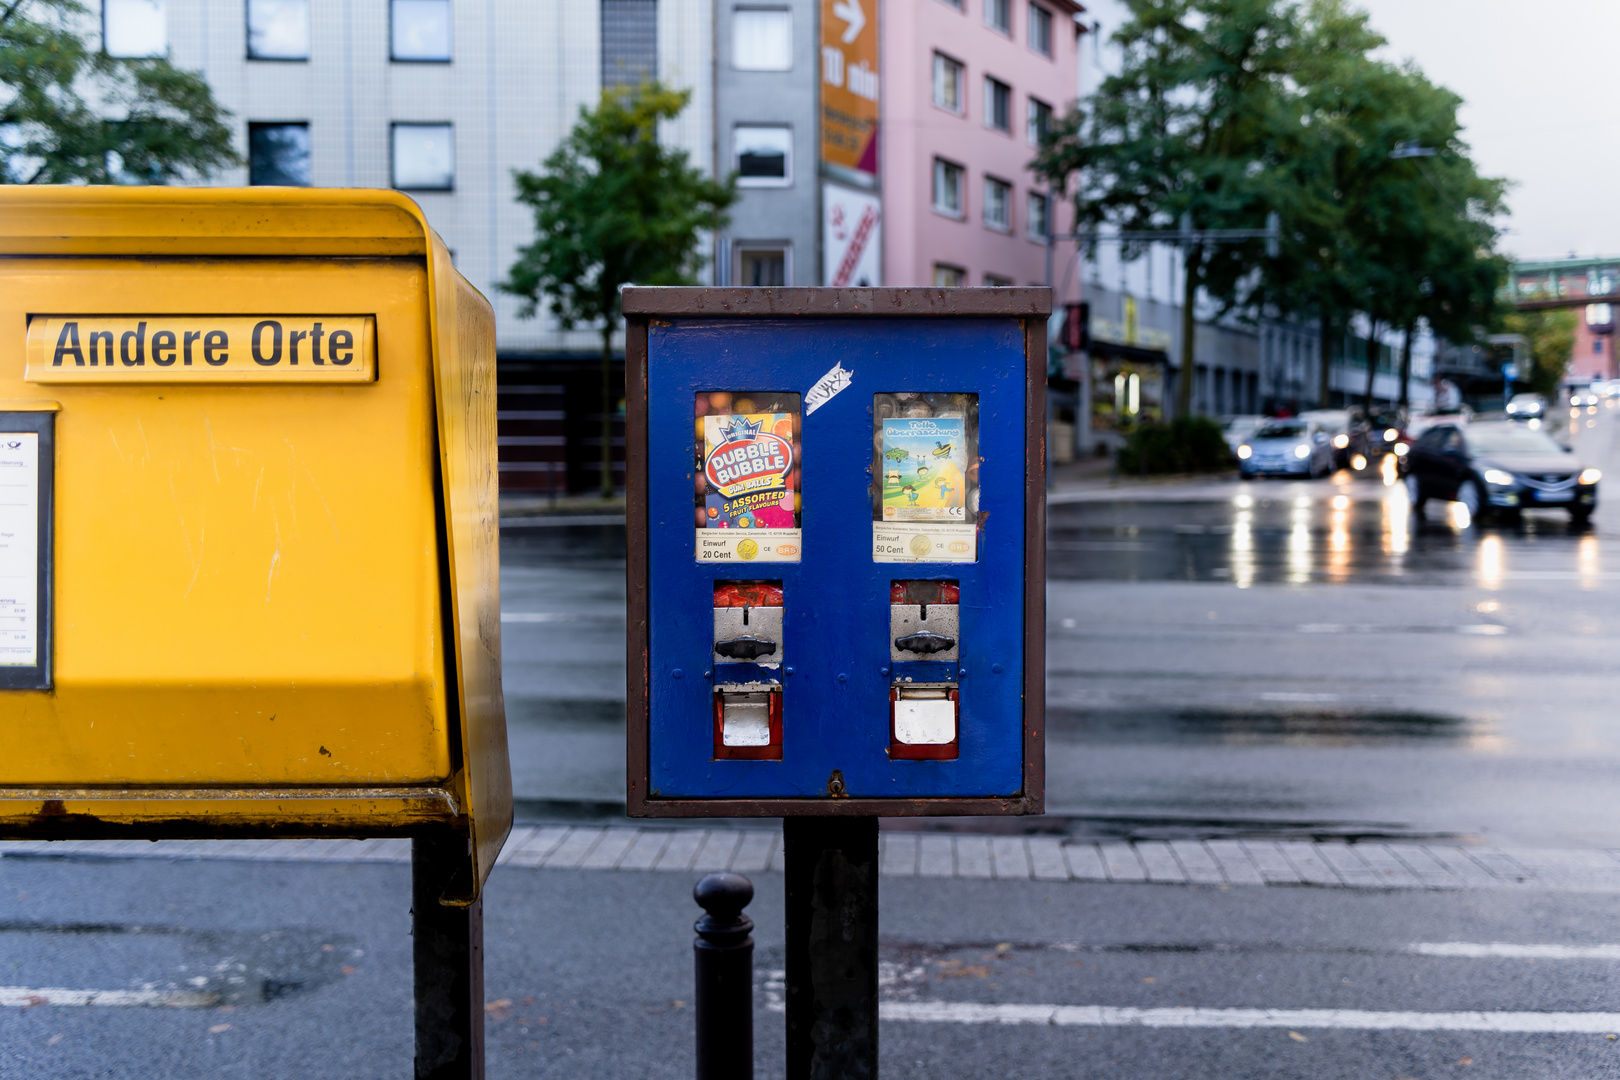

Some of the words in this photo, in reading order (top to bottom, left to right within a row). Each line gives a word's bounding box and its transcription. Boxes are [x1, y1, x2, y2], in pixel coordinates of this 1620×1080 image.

[52, 321, 229, 367] Andere
[251, 320, 354, 366] Orte
[727, 429, 756, 439] ORIGINAL
[909, 420, 936, 430] Tolle
[711, 441, 780, 470] DUBBLE
[716, 455, 785, 484] BUBBLE
[728, 483, 745, 494] GUM
[746, 477, 772, 490] BALLS
[723, 504, 730, 512] 5
[732, 492, 785, 509] ASSORTED
[729, 507, 748, 518] FRUIT
[748, 500, 779, 512] FLAVOURS
